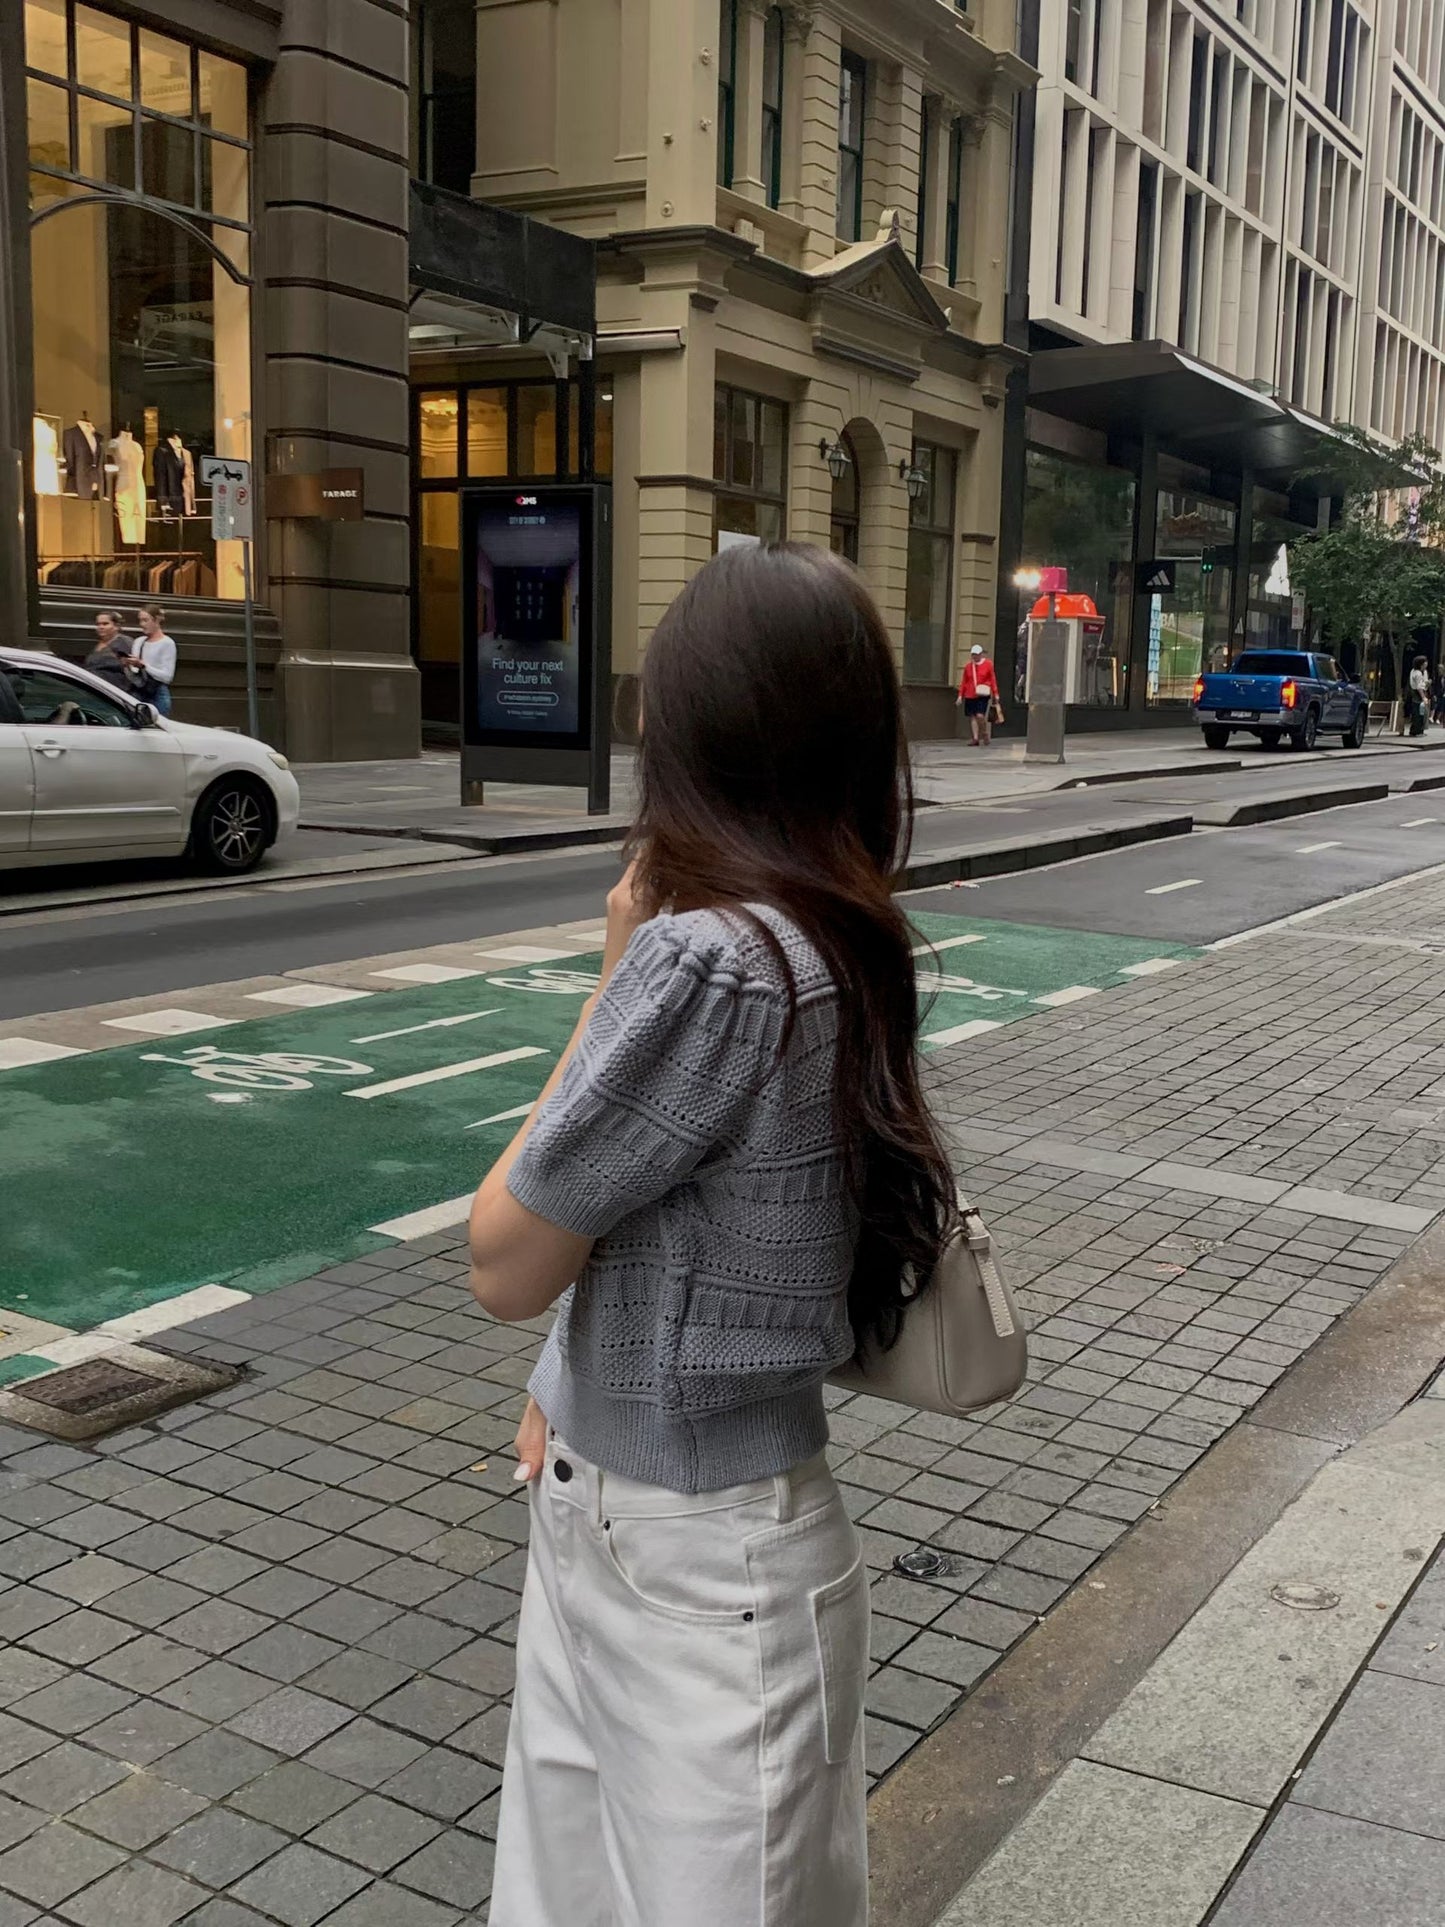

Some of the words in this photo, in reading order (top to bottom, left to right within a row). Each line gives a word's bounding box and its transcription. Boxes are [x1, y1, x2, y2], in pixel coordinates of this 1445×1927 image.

[492, 657, 515, 670] Find
[516, 660, 540, 672] your
[541, 660, 564, 672] next
[503, 672, 538, 684] culture
[540, 672, 552, 685] fix
